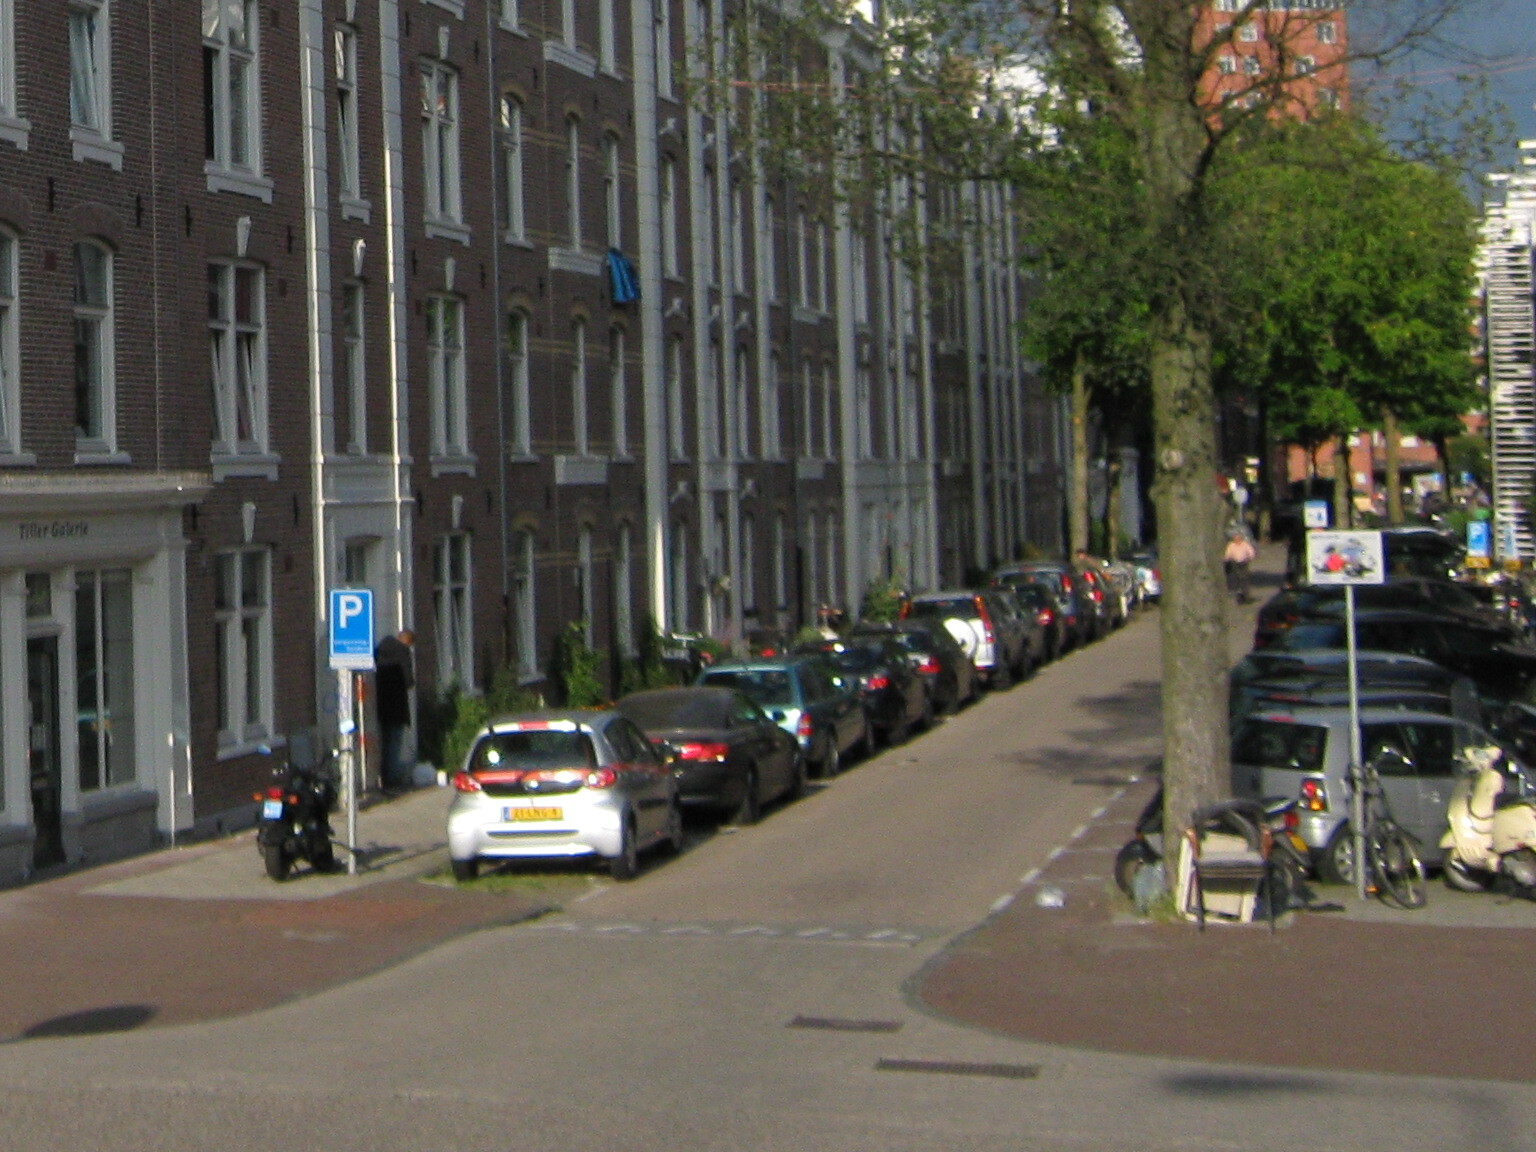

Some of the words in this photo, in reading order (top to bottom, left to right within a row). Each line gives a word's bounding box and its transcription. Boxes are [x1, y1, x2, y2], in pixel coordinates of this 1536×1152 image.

[20, 522, 48, 539] Tiller
[51, 521, 88, 537] Galerie
[339, 594, 363, 628] P
